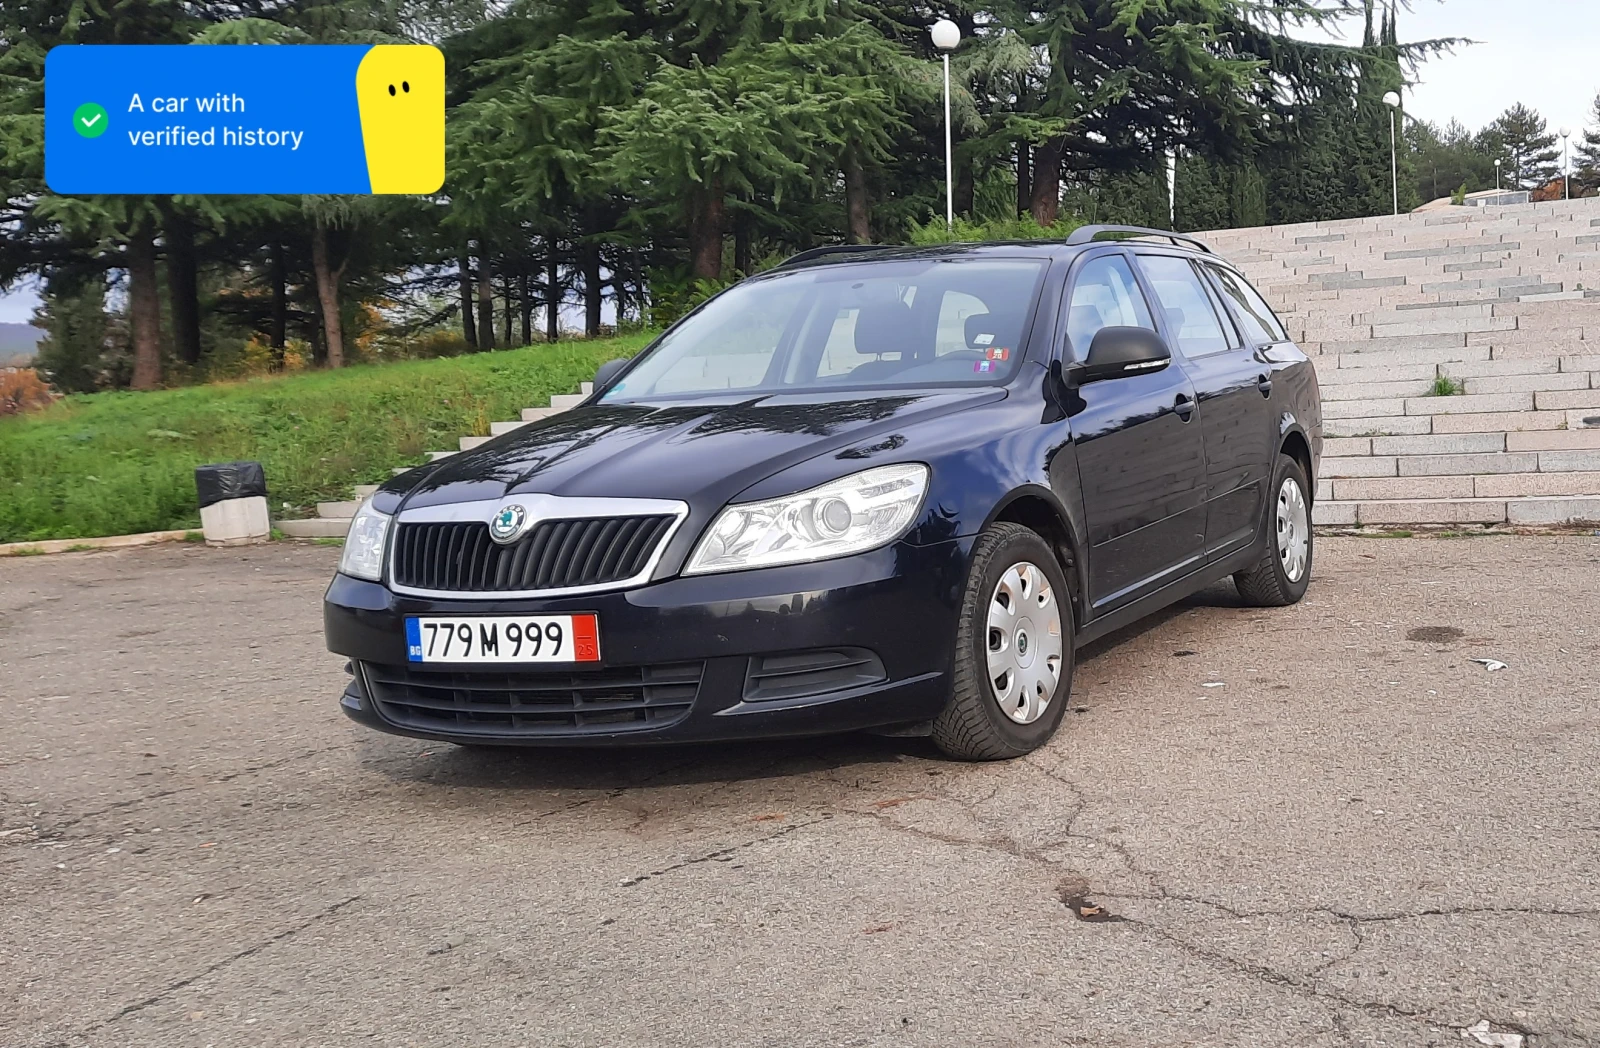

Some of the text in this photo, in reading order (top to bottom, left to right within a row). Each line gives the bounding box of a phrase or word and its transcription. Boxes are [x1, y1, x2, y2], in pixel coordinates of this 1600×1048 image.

[424, 622, 563, 657] 779 M 999
[410, 645, 421, 655] BG
[578, 644, 593, 656] 25
